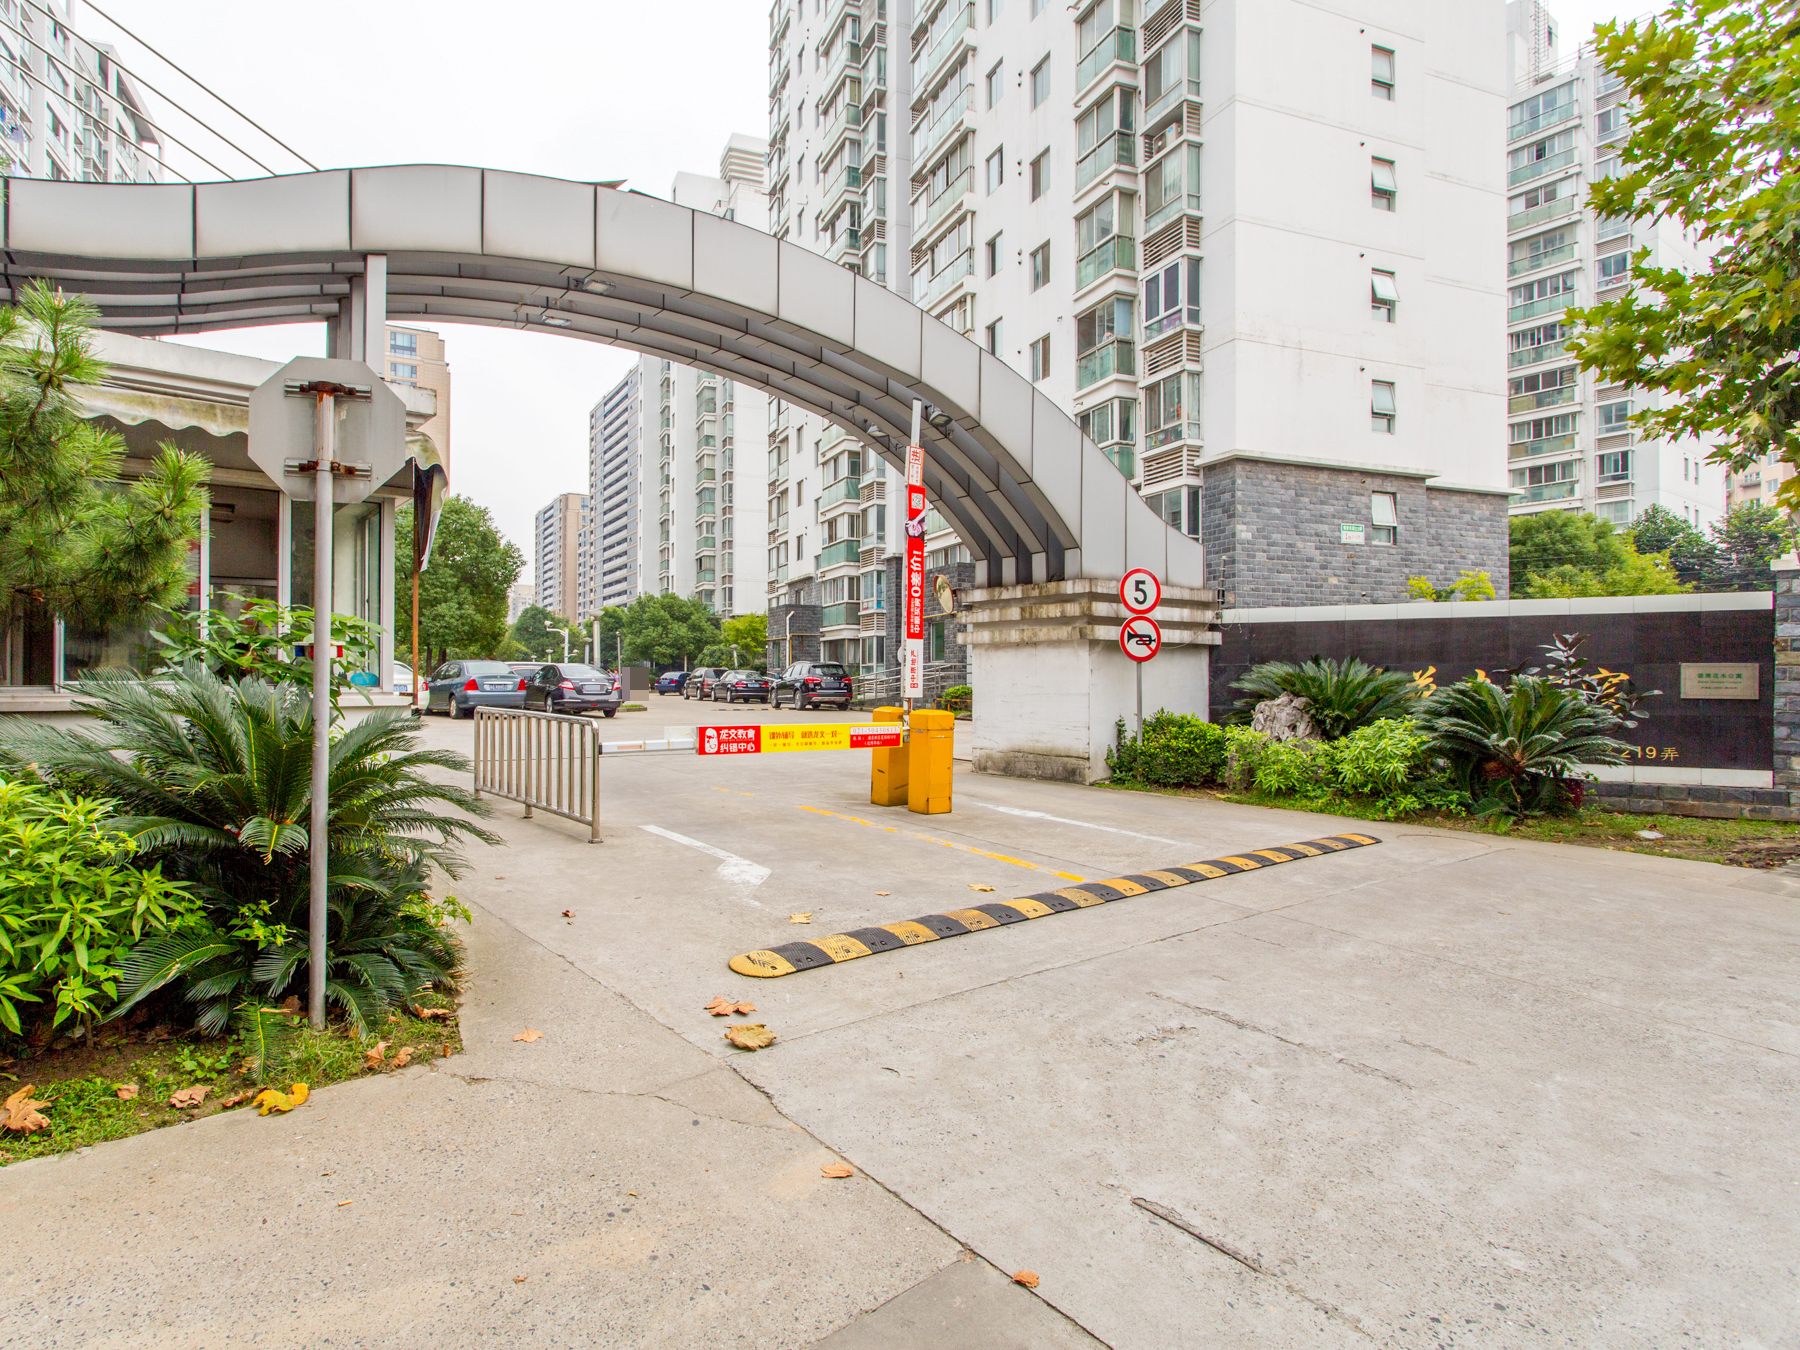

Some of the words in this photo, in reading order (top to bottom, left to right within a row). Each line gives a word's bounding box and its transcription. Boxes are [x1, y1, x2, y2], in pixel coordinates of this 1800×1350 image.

[1133, 580, 1148, 605] 5
[719, 728, 756, 741] 龙文教育
[719, 742, 756, 753] 纠错中心
